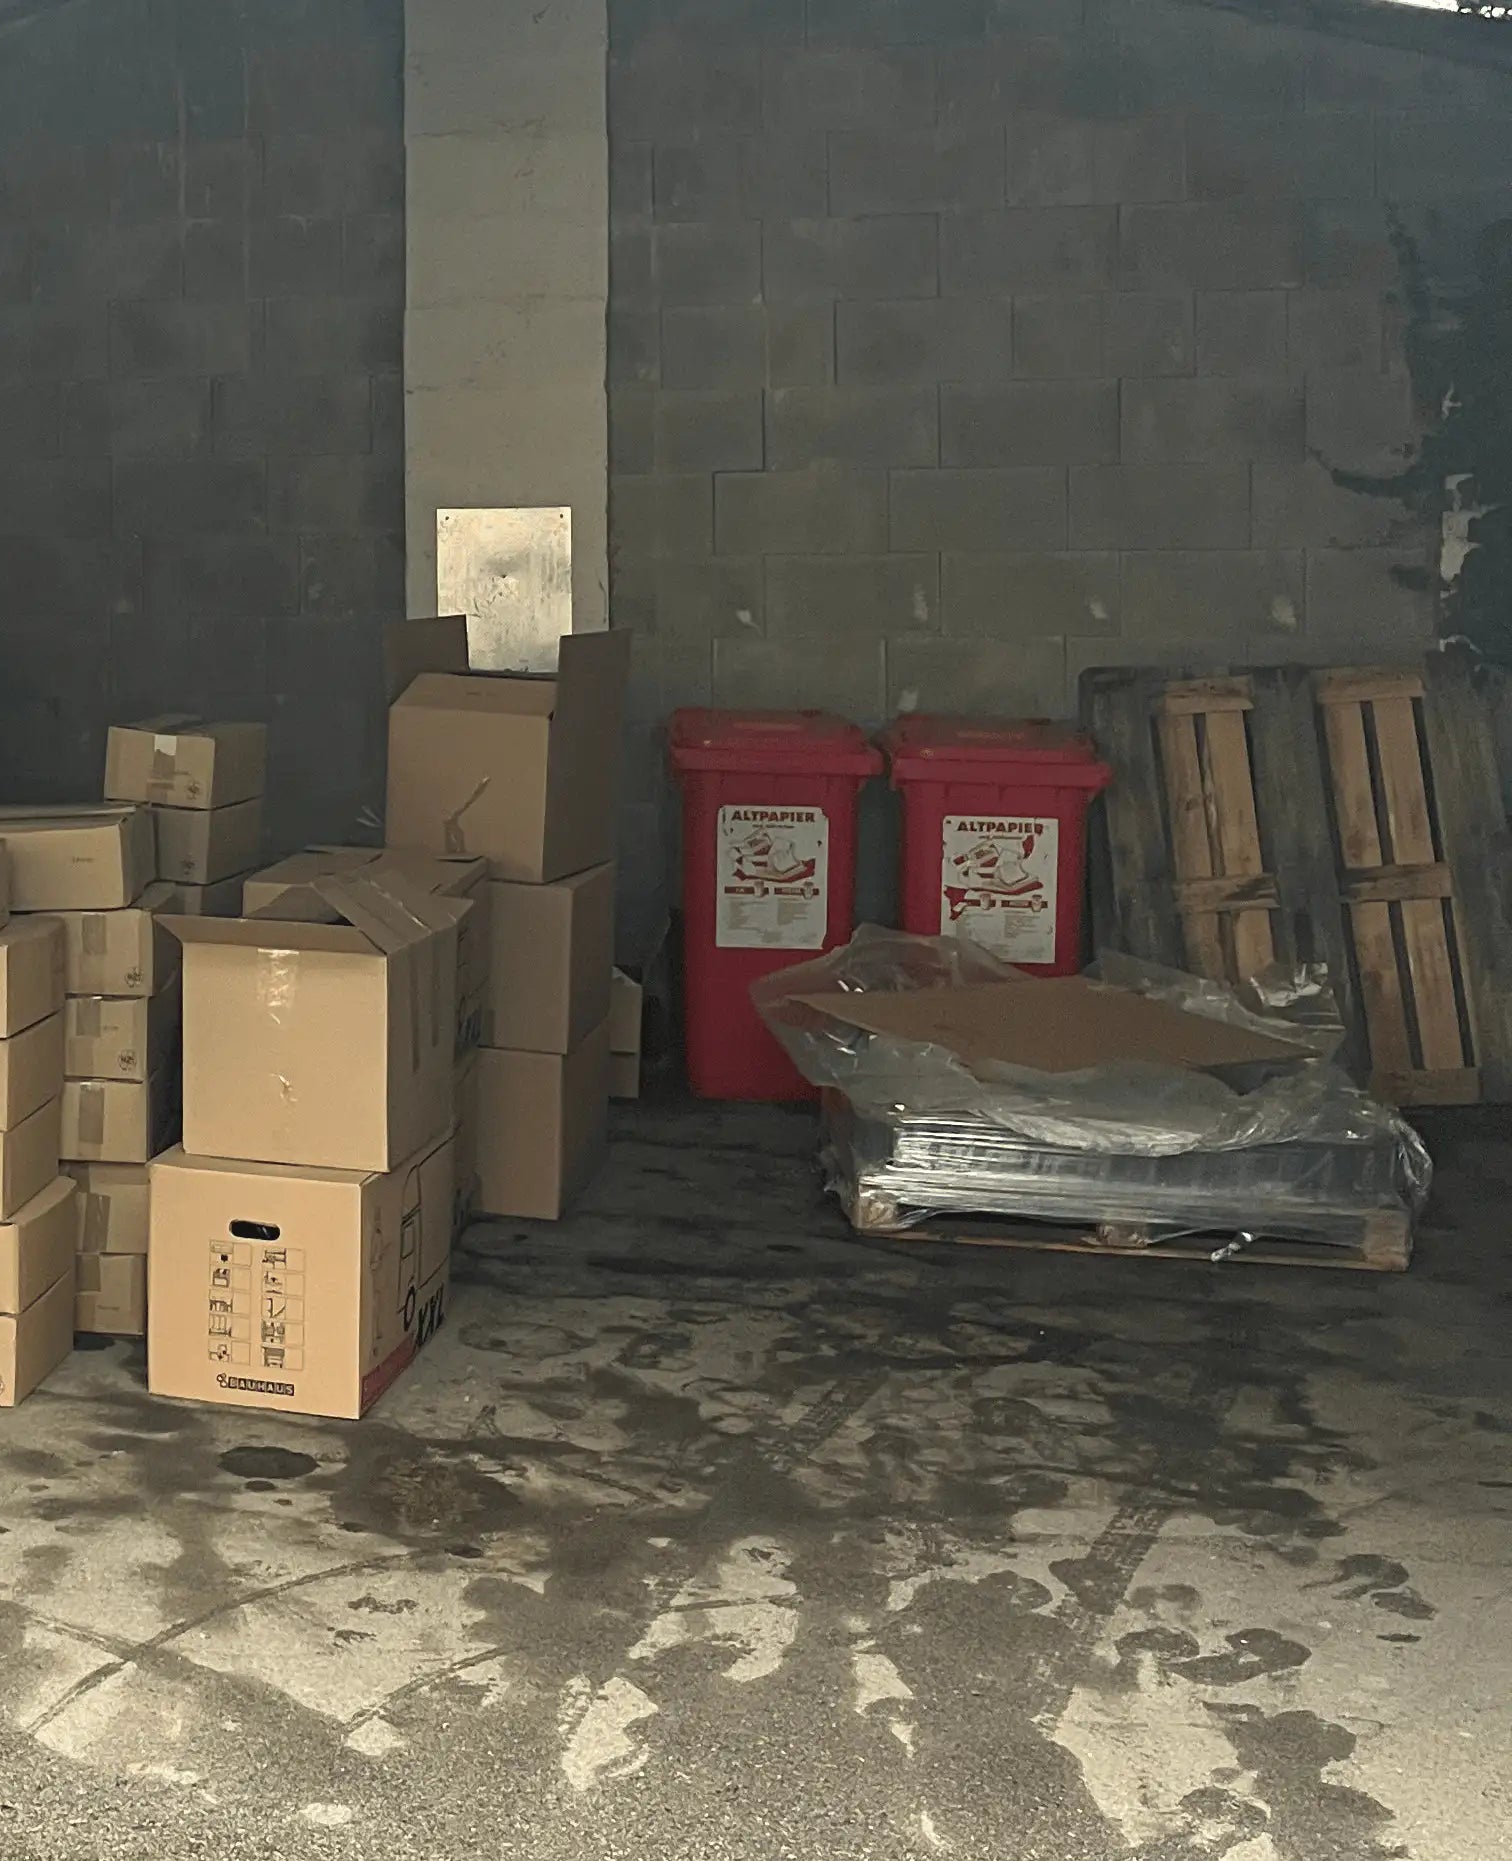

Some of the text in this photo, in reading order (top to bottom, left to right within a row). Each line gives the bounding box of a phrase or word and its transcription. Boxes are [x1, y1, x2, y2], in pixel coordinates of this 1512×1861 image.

[731, 809, 816, 822] ALTPAPIER
[956, 820, 1044, 835] ALTPAPIER
[228, 1376, 295, 1396] BAUHAUS
